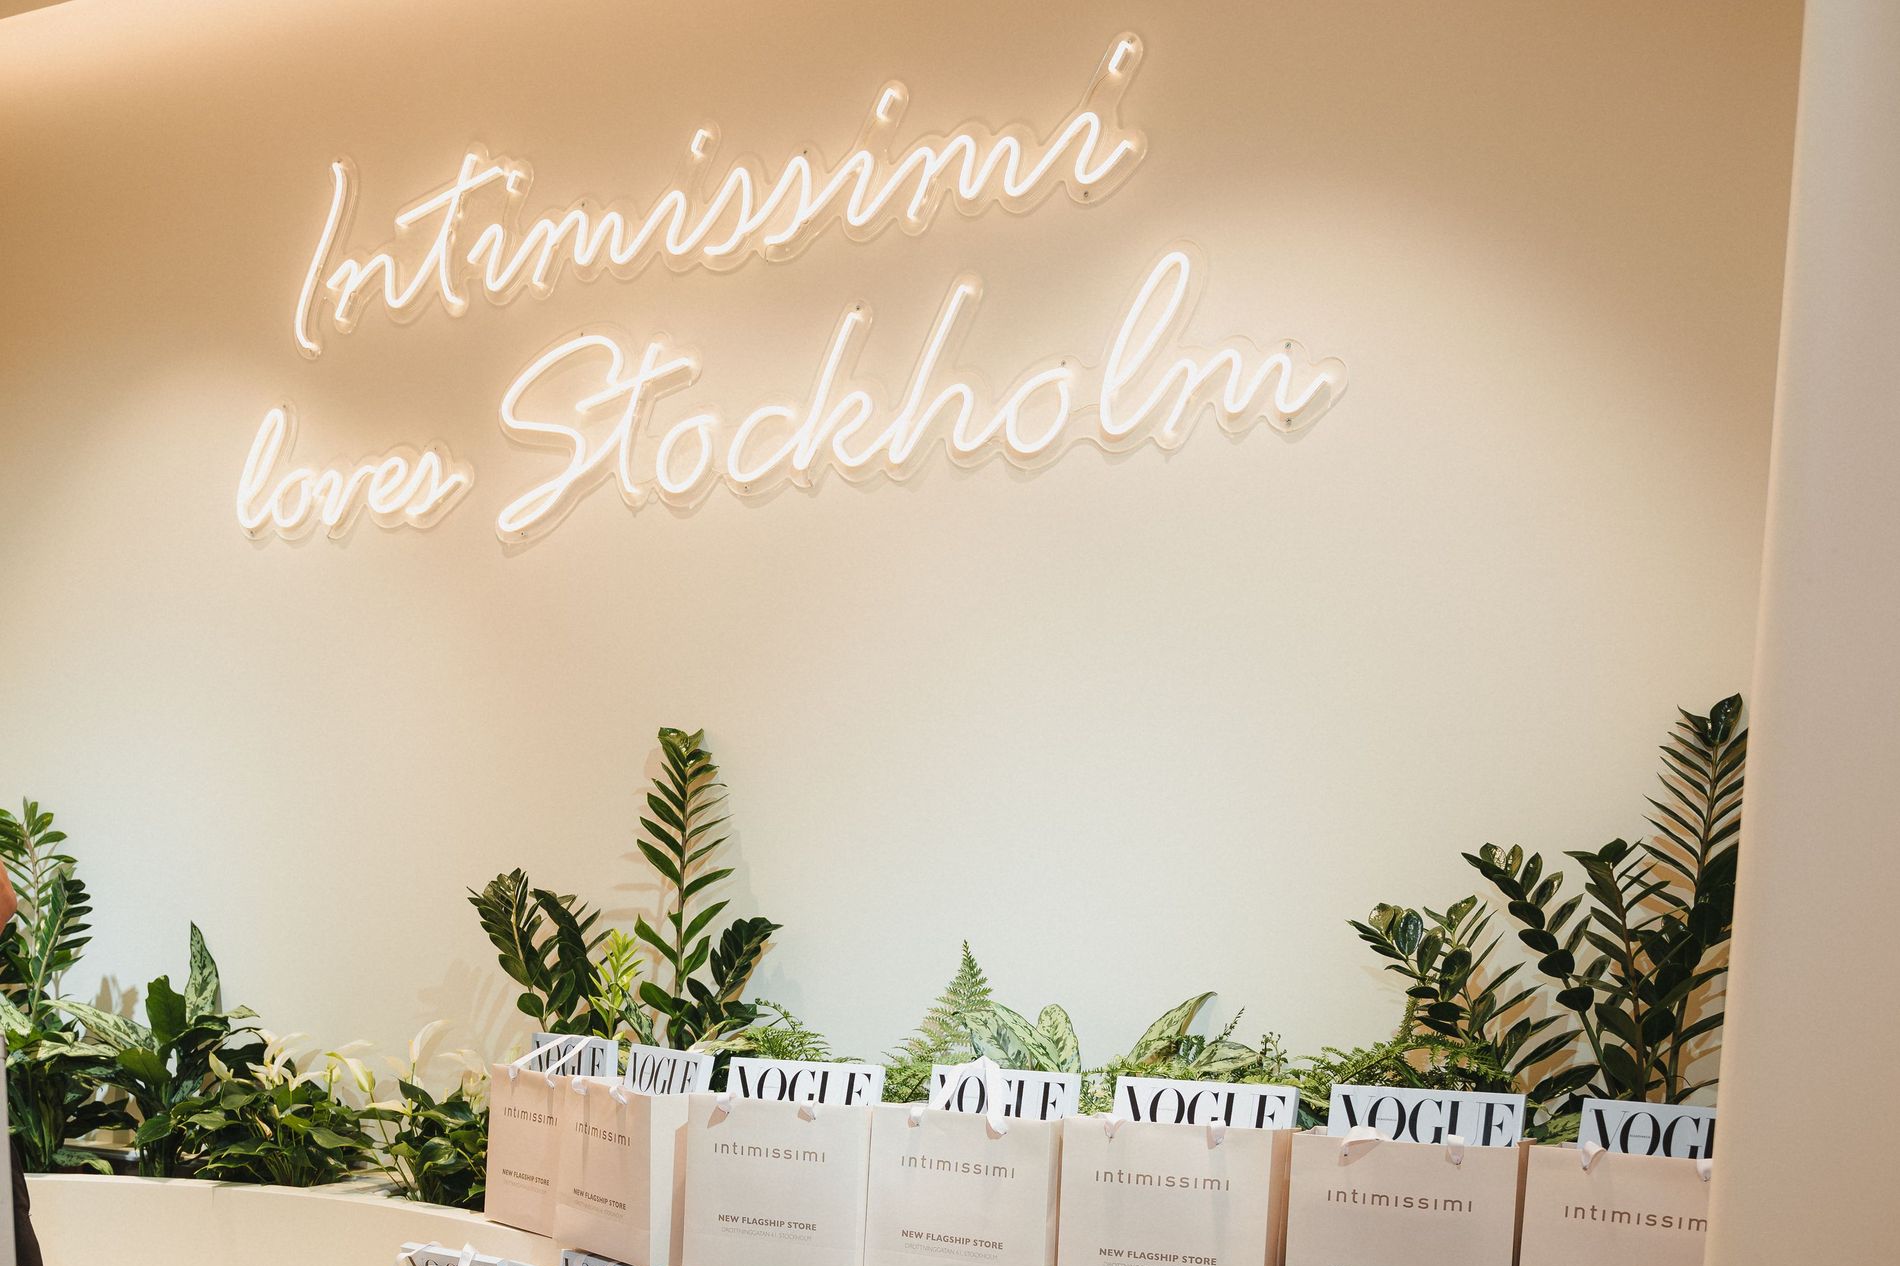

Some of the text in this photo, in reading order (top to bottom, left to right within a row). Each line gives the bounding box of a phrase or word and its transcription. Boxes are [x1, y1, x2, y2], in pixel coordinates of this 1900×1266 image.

[296, 38, 1136, 352] Intimissimi
[236, 250, 1334, 535] loves Stockholm
[631, 1052, 698, 1095] VOGUE
[504, 1107, 558, 1127] intimissimi
[1338, 1094, 1514, 1147] VOGUE
[575, 1122, 631, 1146] intimissimi
[715, 1142, 825, 1163] intimissimi
[902, 1155, 1015, 1178] intimissimi
[513, 1171, 534, 1182] FLAGSHIP
[535, 1177, 549, 1186] STORE
[1096, 1169, 1230, 1191] intimissimi
[573, 1188, 584, 1196] NEW
[585, 1191, 608, 1206] FLAGSHIP
[609, 1199, 626, 1211] STORE
[1328, 1189, 1472, 1213] intimissimi
[719, 1214, 817, 1231] NEW FLAGSHIP STORE
[902, 1230, 1003, 1250] NEW FLAGSHIP STORE
[1099, 1248, 1217, 1266] NEW FLAGSHIP STORE
